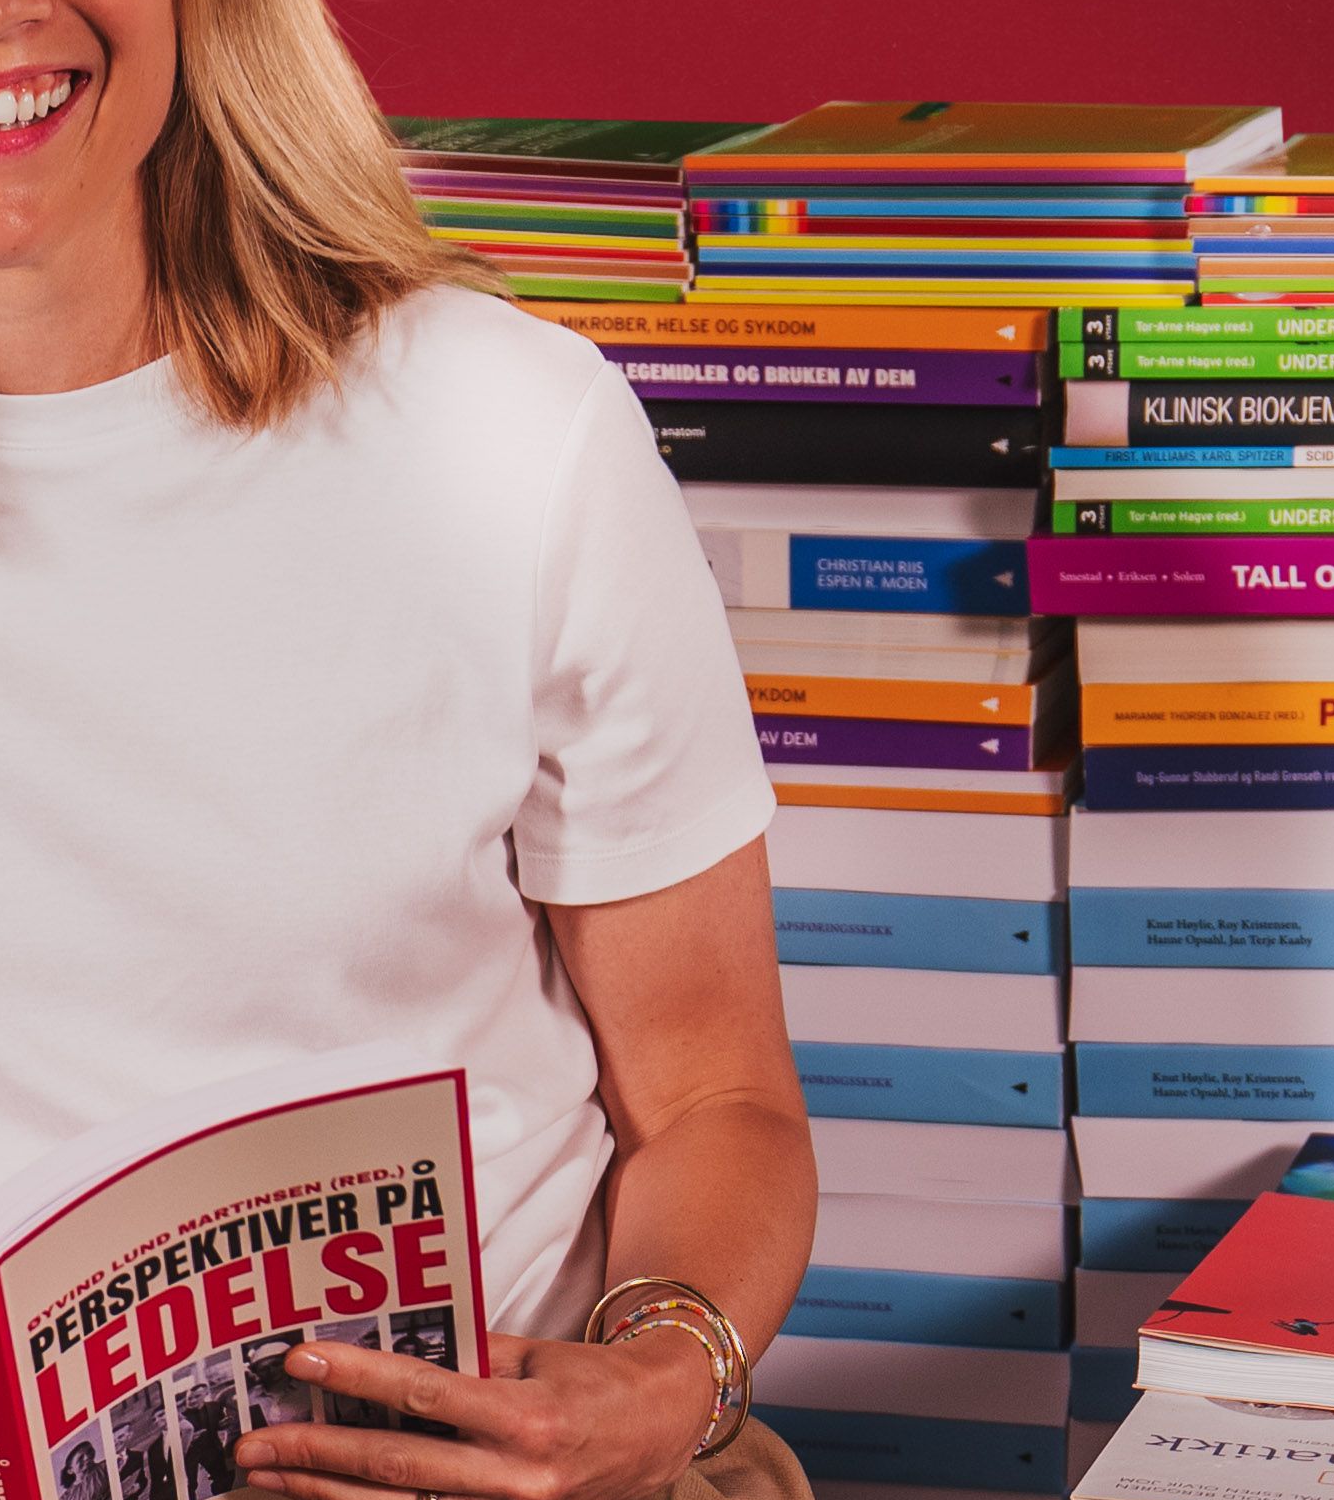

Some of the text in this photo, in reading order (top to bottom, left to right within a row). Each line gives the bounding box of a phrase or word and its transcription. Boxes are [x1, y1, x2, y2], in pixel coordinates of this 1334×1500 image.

[656, 317, 709, 335] HELSE
[715, 318, 739, 335] OG
[745, 319, 816, 336] SYKDOM
[619, 362, 916, 388] LEGEMIDLER OG BRUKEN AV DEM
[1144, 395, 1233, 425] KLINISK
[661, 425, 706, 438] anatomi
[1105, 450, 1140, 463] FIRST,
[1142, 450, 1198, 463] WILLIAMS,
[817, 558, 923, 574] CHRISTIAN RIIS
[817, 575, 928, 592] ESPEN R. MOEN
[1059, 571, 1103, 583] Smestad
[1117, 571, 1157, 583] Eriksen
[1231, 564, 1307, 589] TALL
[1114, 710, 1271, 723] MARIANNE THORSEN GONZALEZ
[760, 732, 818, 747] AV DEM
[26, 1165, 405, 1333] ØYVIND LUND MARTINSEN (RED.)
[28, 1192, 360, 1374] PERSPEKTIVER
[377, 1159, 444, 1228] PÅ
[36, 1218, 454, 1449] LEDELSE
